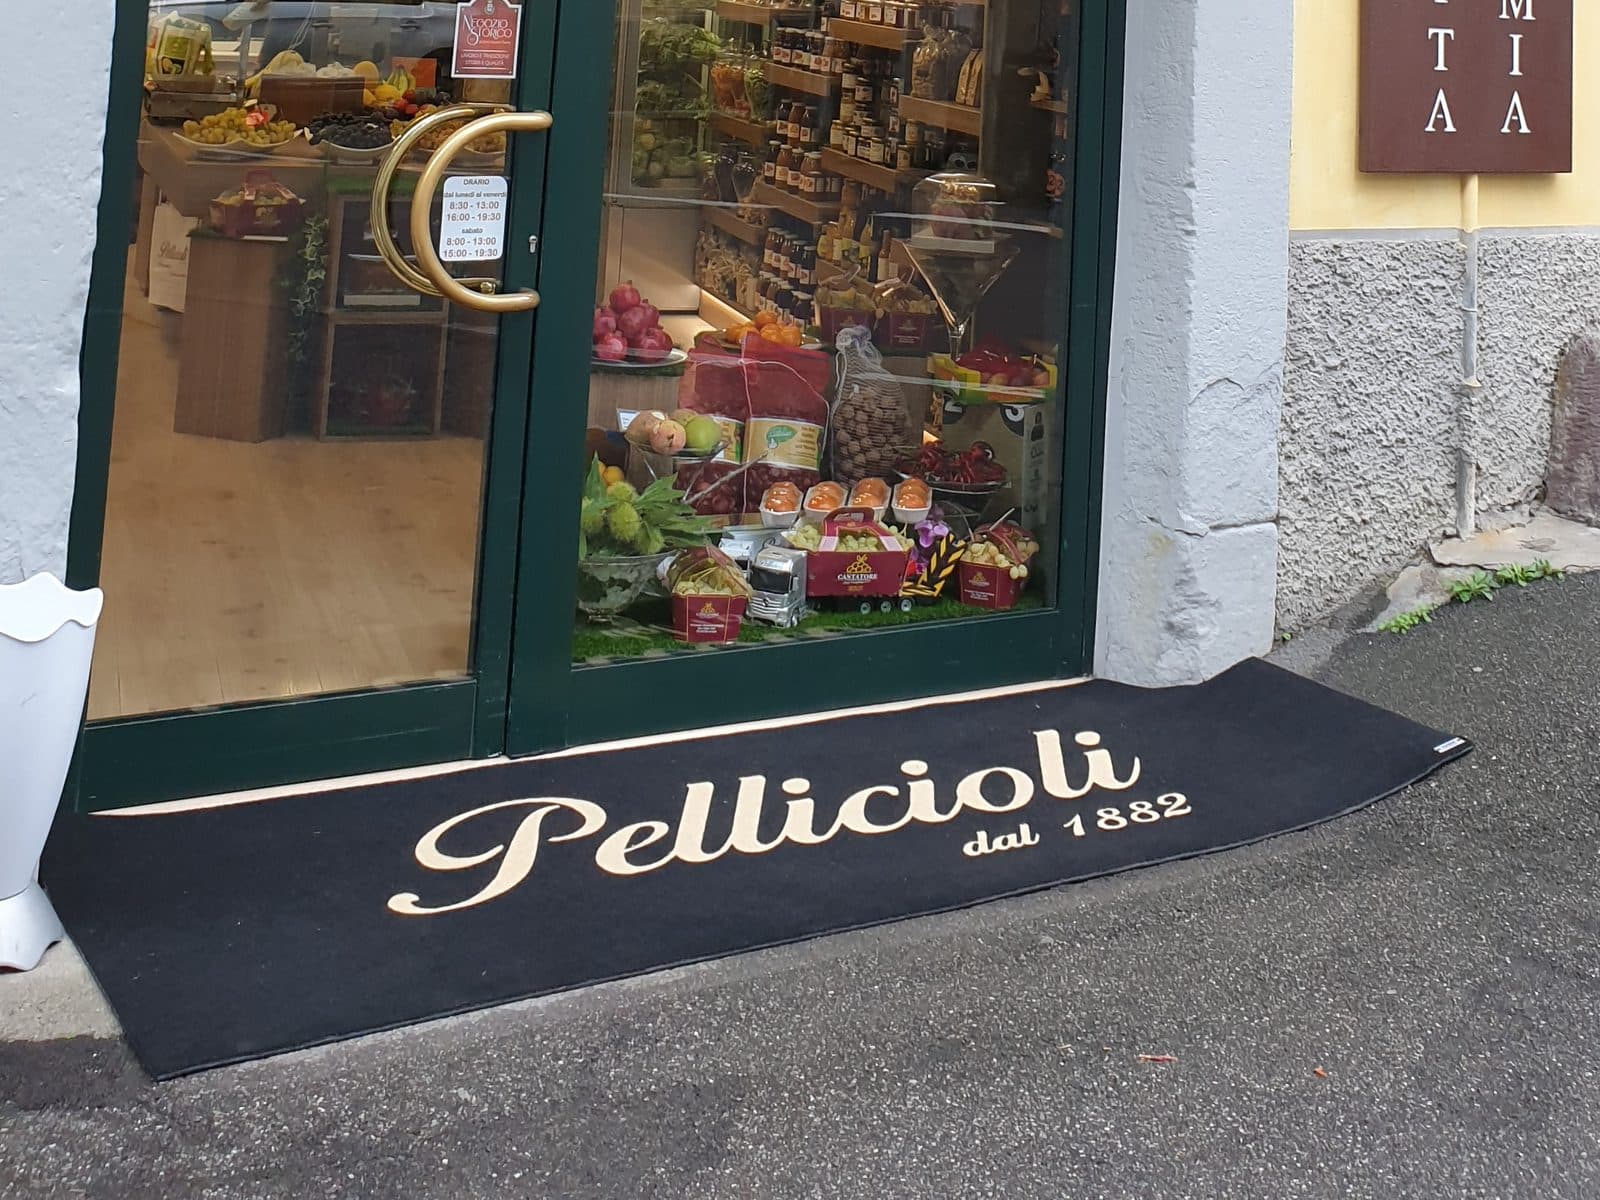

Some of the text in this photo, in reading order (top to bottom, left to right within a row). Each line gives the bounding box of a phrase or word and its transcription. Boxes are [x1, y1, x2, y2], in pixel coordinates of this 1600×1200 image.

[463, 15, 509, 31] NEGOZIO
[466, 26, 513, 46] STORICO
[1424, 0, 1458, 132] TA
[463, 178, 490, 186] ORARIO
[449, 201, 469, 210] 8:30
[476, 201, 500, 210] 13:00
[447, 213, 470, 221] 16:00
[477, 212, 501, 221] 19:30
[446, 237, 466, 246] 8:00
[473, 237, 497, 245] 13:00
[444, 249, 468, 258] 15:00
[475, 248, 498, 257] 19:30
[385, 729, 1141, 917] Pellicioli
[962, 792, 1192, 857] dal 1882
